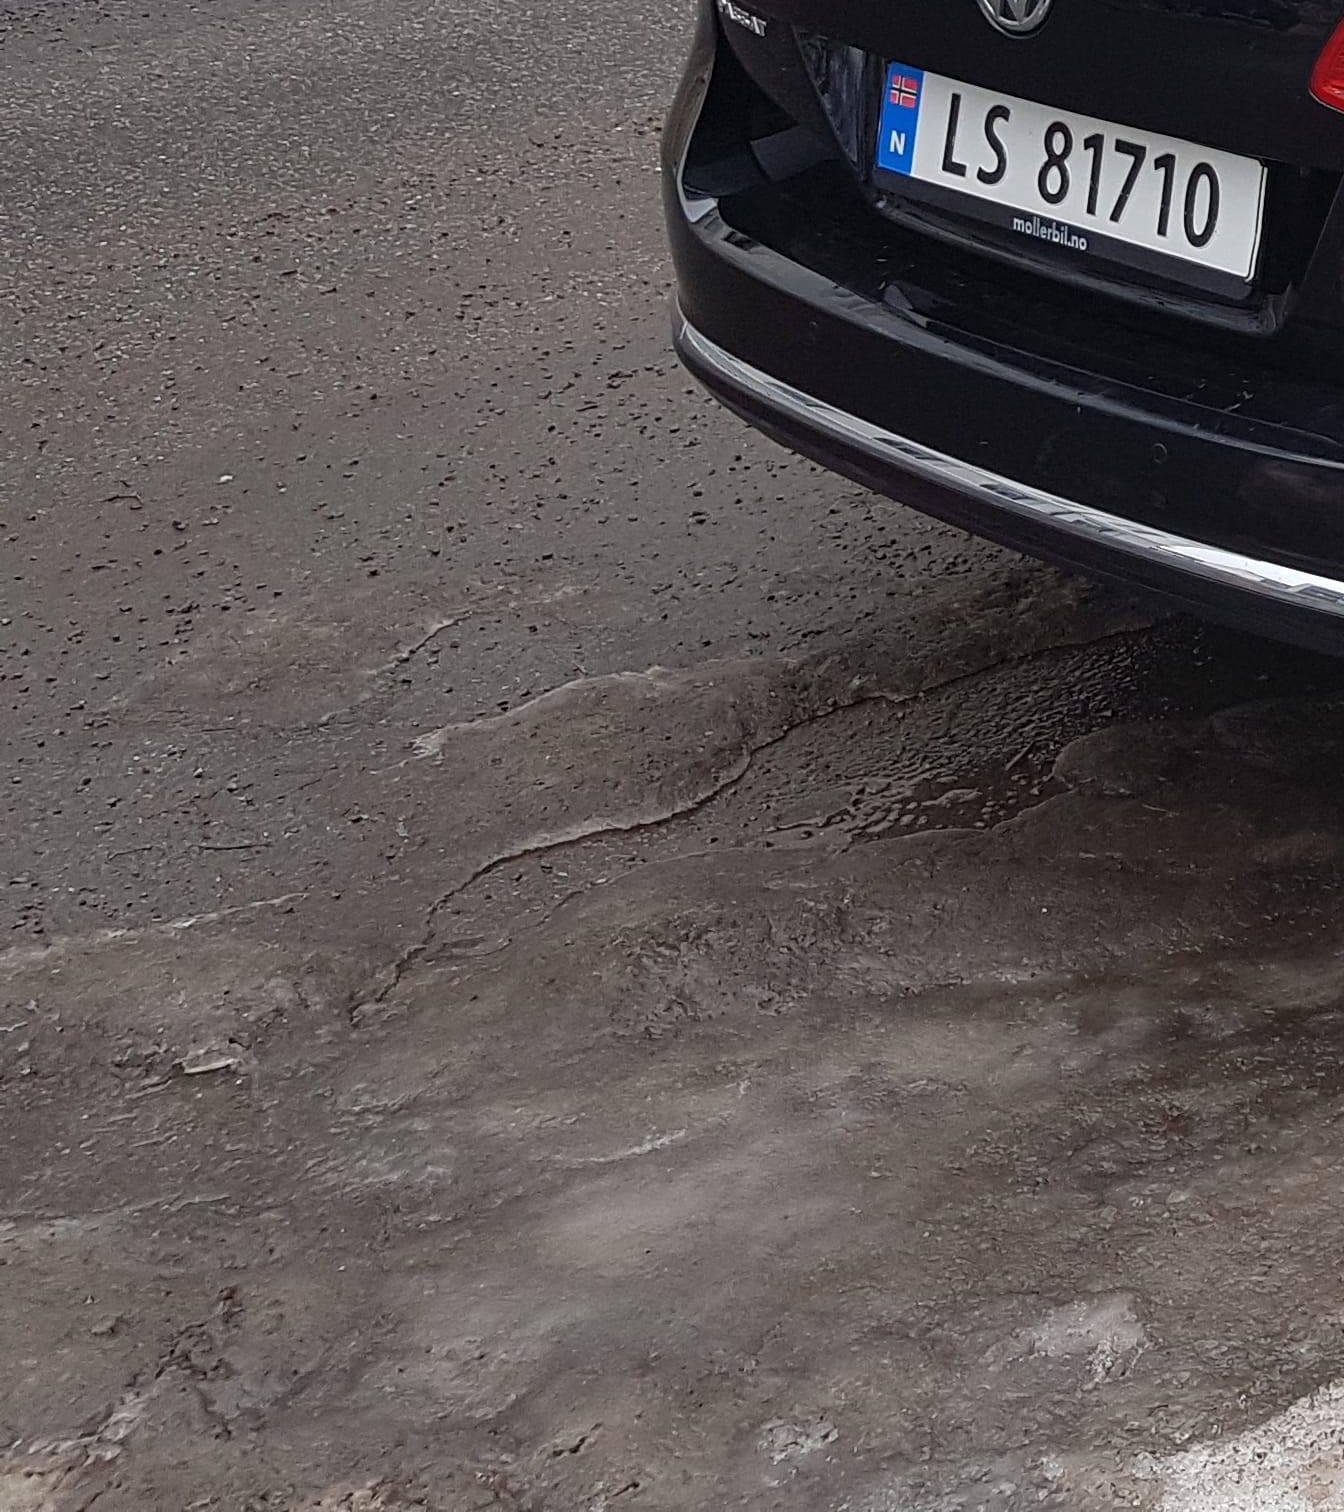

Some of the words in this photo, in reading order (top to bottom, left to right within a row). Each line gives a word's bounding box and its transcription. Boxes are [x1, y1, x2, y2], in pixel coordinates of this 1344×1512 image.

[889, 131, 906, 155] N
[941, 92, 1011, 185] LS
[1037, 121, 1220, 248] 81710
[1012, 216, 1088, 251] mollerbil.no
